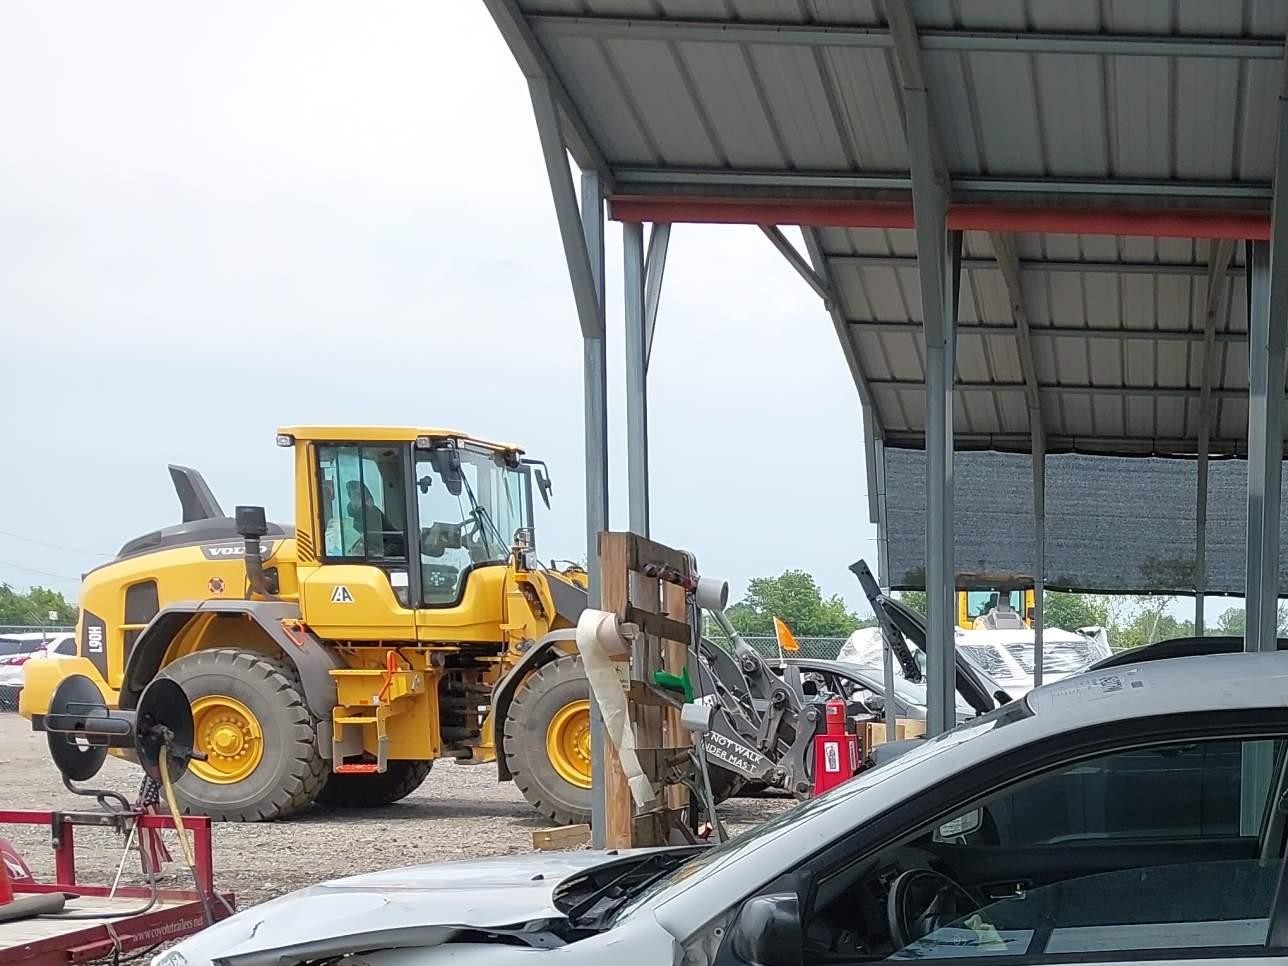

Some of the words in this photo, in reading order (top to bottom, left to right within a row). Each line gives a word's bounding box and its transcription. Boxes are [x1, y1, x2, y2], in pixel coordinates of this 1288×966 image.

[208, 546, 268, 556] VOLO
[88, 626, 102, 653] L90H
[705, 742, 727, 760] NDER
[729, 754, 757, 772] MAST
[711, 733, 732, 748] NOT
[735, 745, 764, 764] WALK
